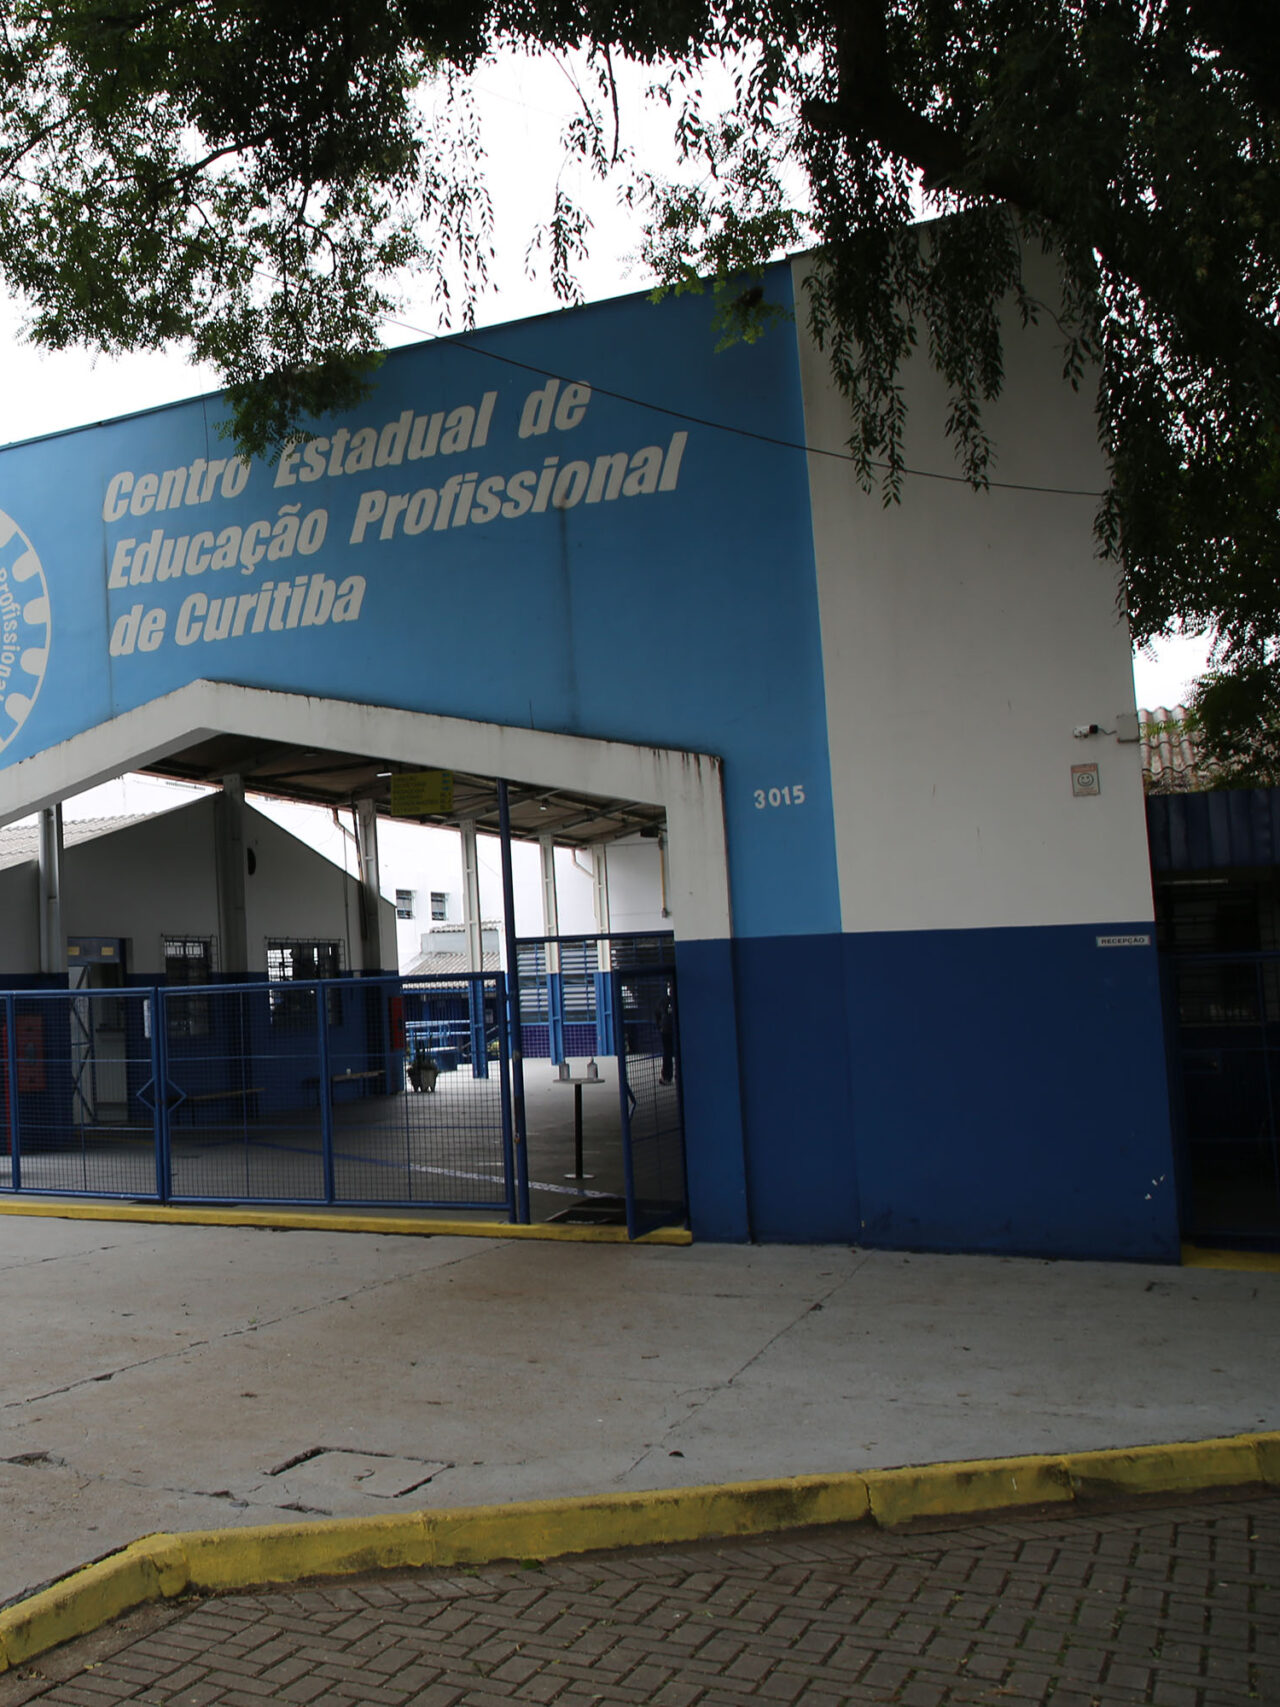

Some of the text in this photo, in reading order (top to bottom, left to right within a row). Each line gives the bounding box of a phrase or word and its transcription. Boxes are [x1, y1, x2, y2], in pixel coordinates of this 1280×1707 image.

[102, 379, 591, 522] Centro Estadual de
[108, 432, 688, 590] Educação Profissional
[109, 574, 367, 657] de Curitiba
[754, 785, 805, 809] 3015
